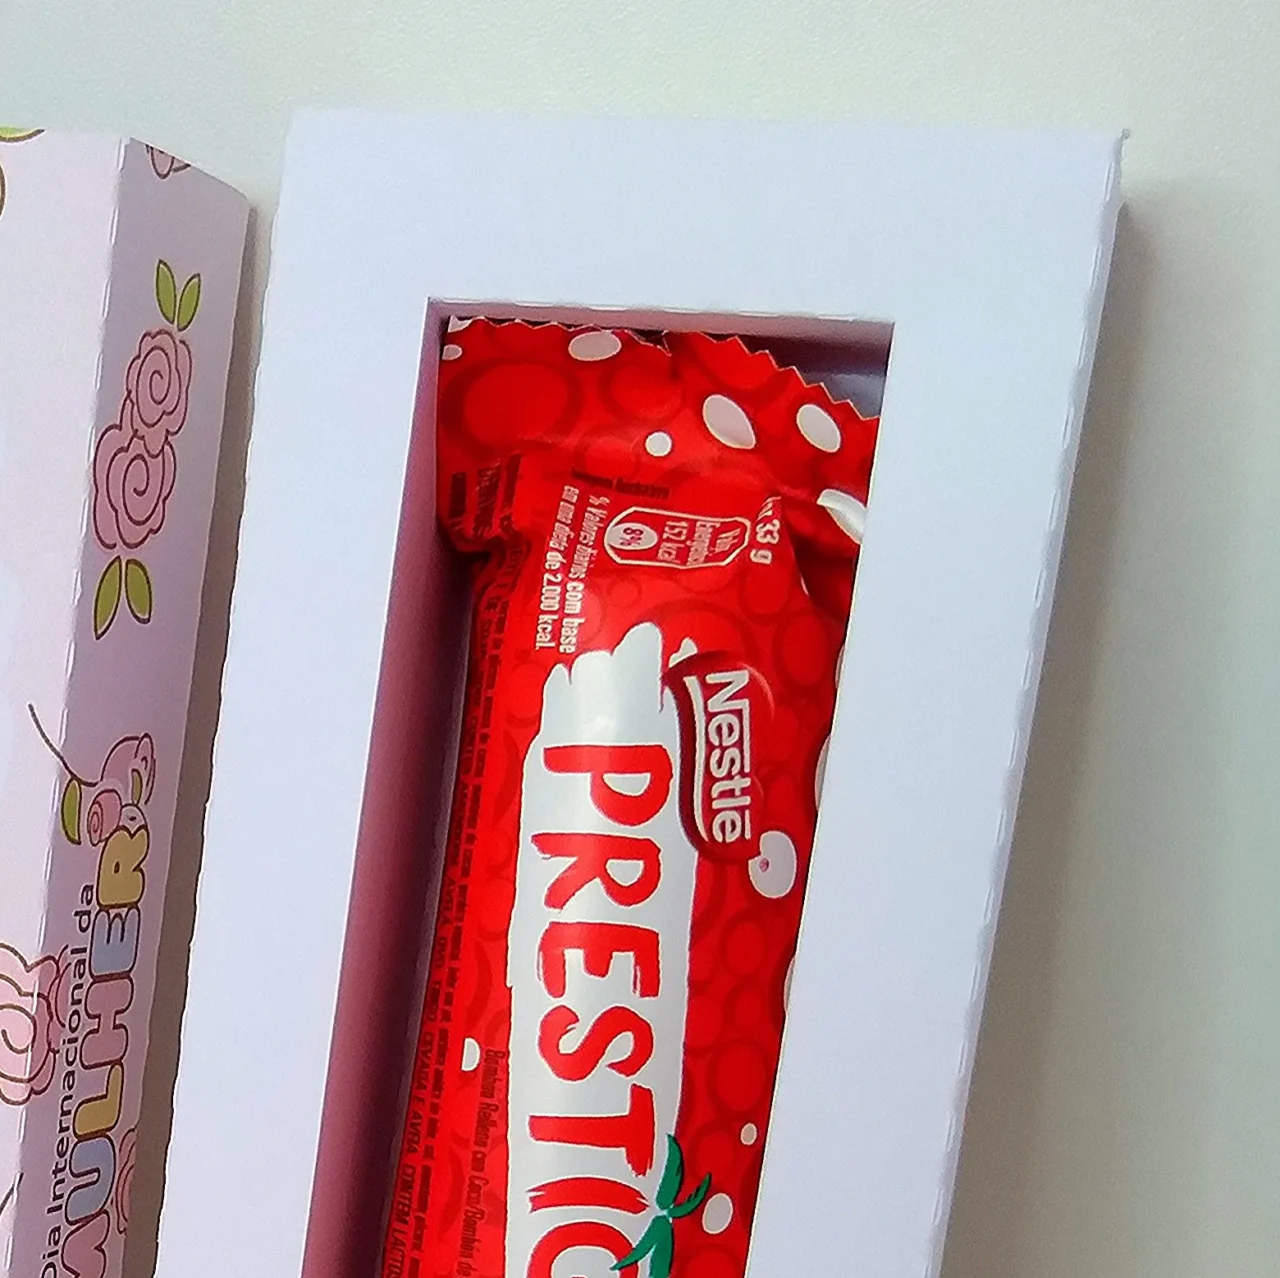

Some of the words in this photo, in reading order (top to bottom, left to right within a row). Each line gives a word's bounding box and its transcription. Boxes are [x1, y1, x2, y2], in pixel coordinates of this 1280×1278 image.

[619, 527, 644, 546] 8%
[662, 520, 688, 541] 152
[756, 519, 781, 545] 33
[545, 551, 567, 569] de
[750, 549, 772, 565] g
[540, 573, 564, 611] 2.000
[564, 581, 586, 613] com
[535, 615, 560, 652] kcal.
[559, 618, 586, 655] base
[46, 946, 88, 1215] Internacional
[73, 884, 95, 933] da
[456, 1261, 478, 1278] de
